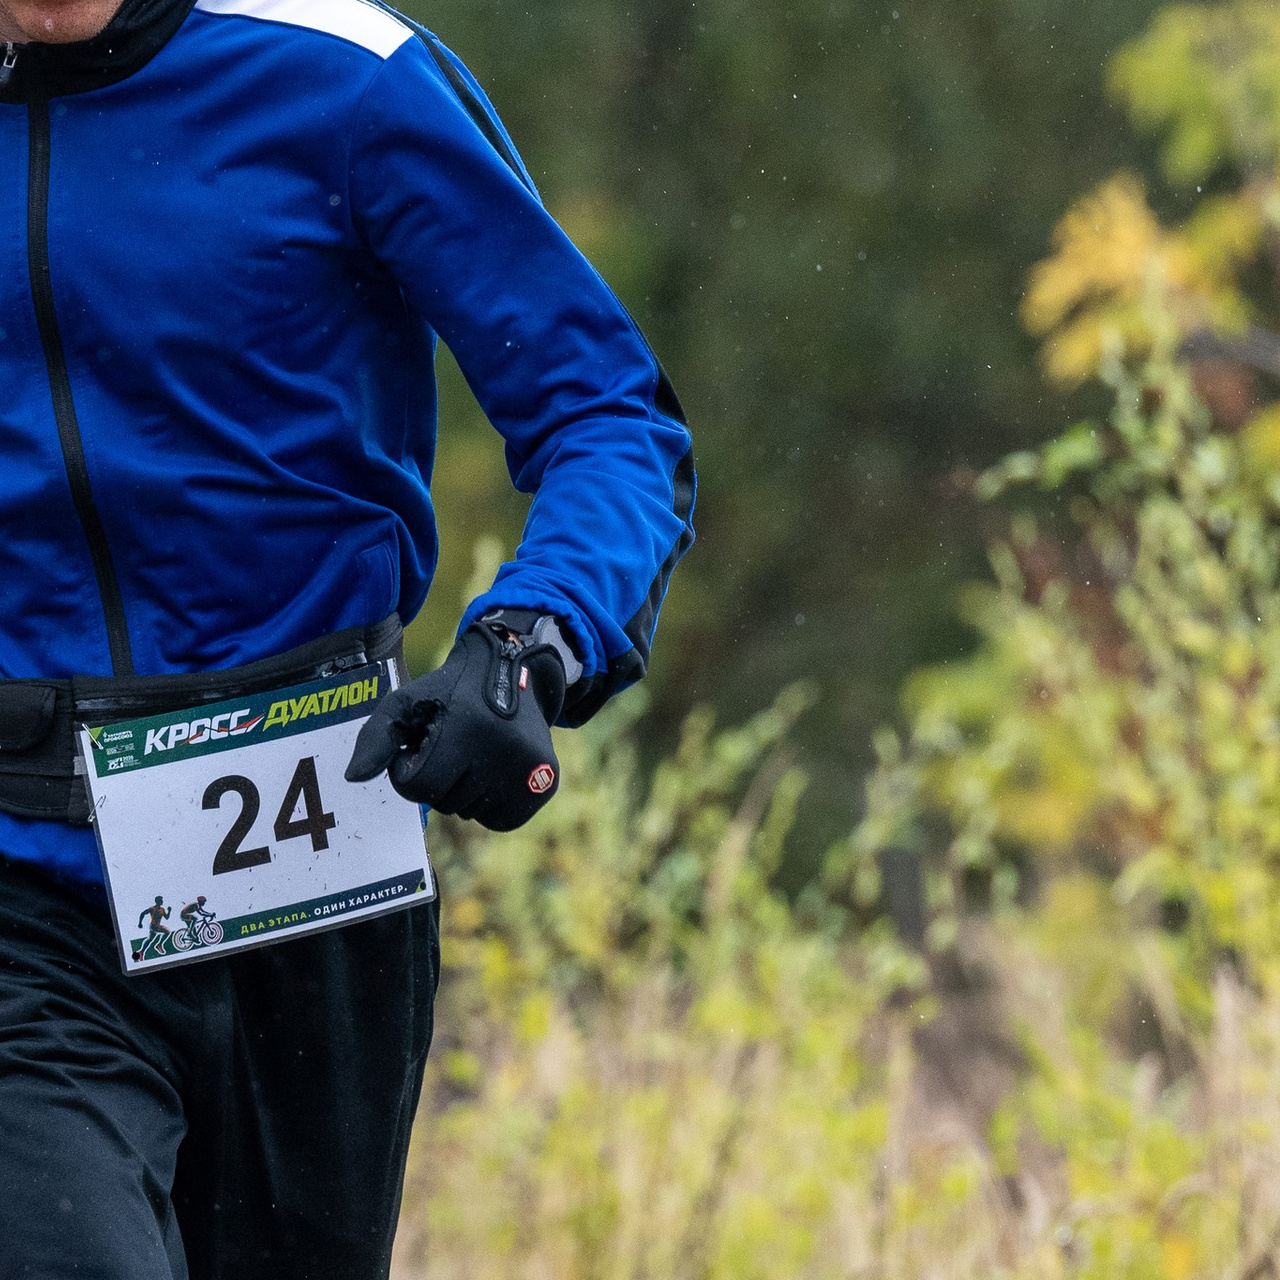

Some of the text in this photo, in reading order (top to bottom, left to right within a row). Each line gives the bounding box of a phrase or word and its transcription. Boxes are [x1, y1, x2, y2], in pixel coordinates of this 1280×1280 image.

[144, 676, 378, 755] КРОСС ДУАТЛОН
[201, 756, 337, 876] 24
[240, 885, 408, 935] ДВА ЭТАПА. ОДИН ХАРАКТЕР.
